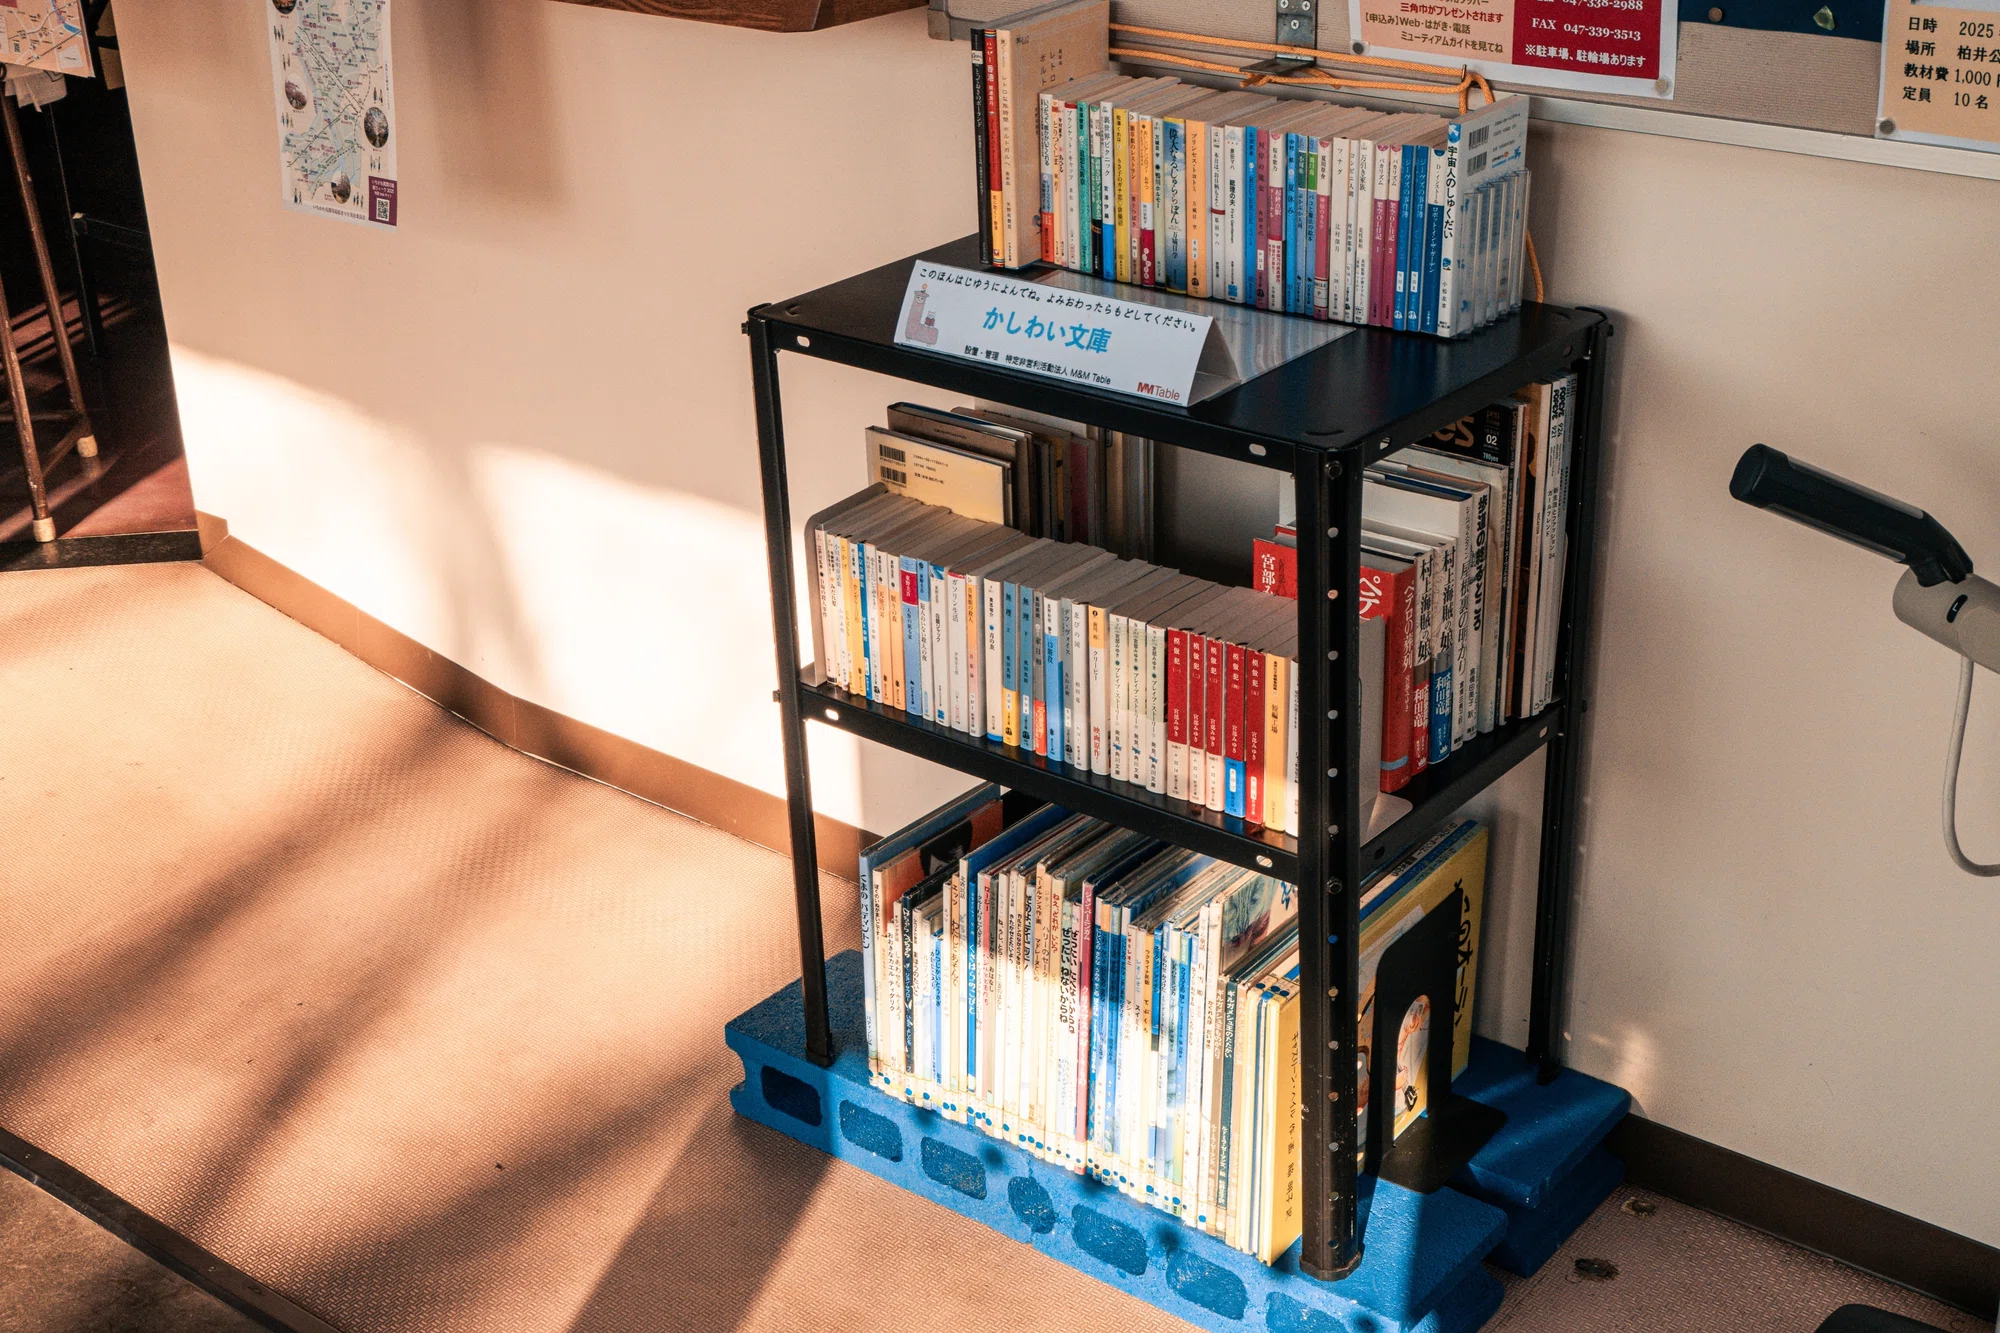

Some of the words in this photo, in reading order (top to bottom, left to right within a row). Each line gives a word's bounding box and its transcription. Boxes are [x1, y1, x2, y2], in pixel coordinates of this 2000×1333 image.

[1400, 2, 1504, 23] 三角巾がプレゼントされます
[1532, 18, 1556, 30] FAX
[1563, 23, 1642, 41] 047-339-3513
[1908, 17, 1938, 33] 日時
[1959, 21, 1994, 38] 2025
[1905, 39, 1936, 56] 場所
[1903, 63, 1949, 81] 教材費
[1955, 68, 1992, 86] 1,000
[1902, 86, 1932, 103] 定員
[1359, 154, 1368, 192] 万引き家族
[1443, 145, 1458, 239] 宇宙人のしゅくだい
[982, 306, 1113, 354] かしわい文庫
[1070, 368, 1091, 381] M&M
[1092, 373, 1111, 385] Table
[1551, 389, 1560, 421] POPEYE
[1558, 386, 1567, 418] POPEYE
[1486, 434, 1498, 446] 02
[951, 578, 959, 623] ガソリン生活
[1417, 554, 1434, 663] 村上海賊の娘
[1440, 546, 1456, 653] 村上海賊の娘
[1073, 611, 1081, 649] 忍びの国
[1402, 579, 1415, 673] ペテロの葬列
[1458, 562, 1470, 677] 屋根裏の明かり
[860, 874, 868, 900] くまの
[861, 903, 870, 949] パディントン
[1082, 891, 1092, 941] ジョン・バーニンガム
[1061, 927, 1071, 964] ぜったい
[1070, 930, 1079, 966] ぜったい
[1059, 966, 1070, 1023] ねないからね
